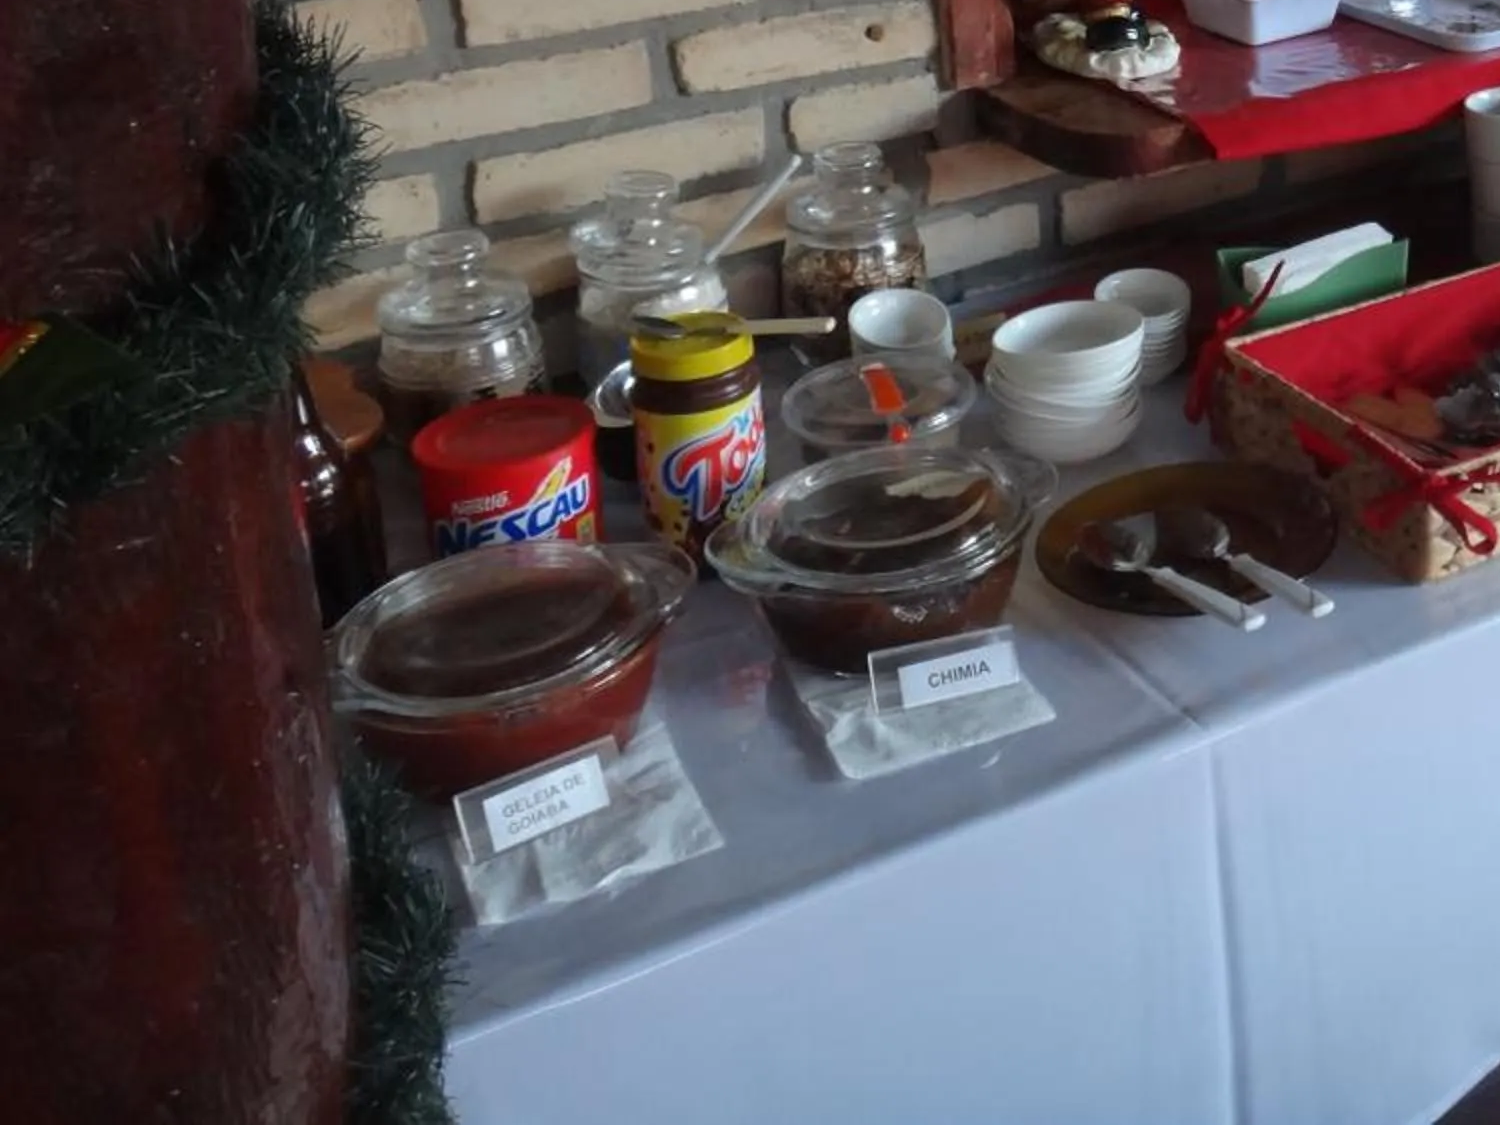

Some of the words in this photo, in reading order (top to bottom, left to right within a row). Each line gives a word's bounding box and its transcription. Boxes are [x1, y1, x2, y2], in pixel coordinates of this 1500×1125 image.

[927, 659, 992, 689] CHIMIA
[500, 783, 562, 819] GELEIA
[562, 772, 587, 791] DE
[506, 799, 571, 836] GOIABA
